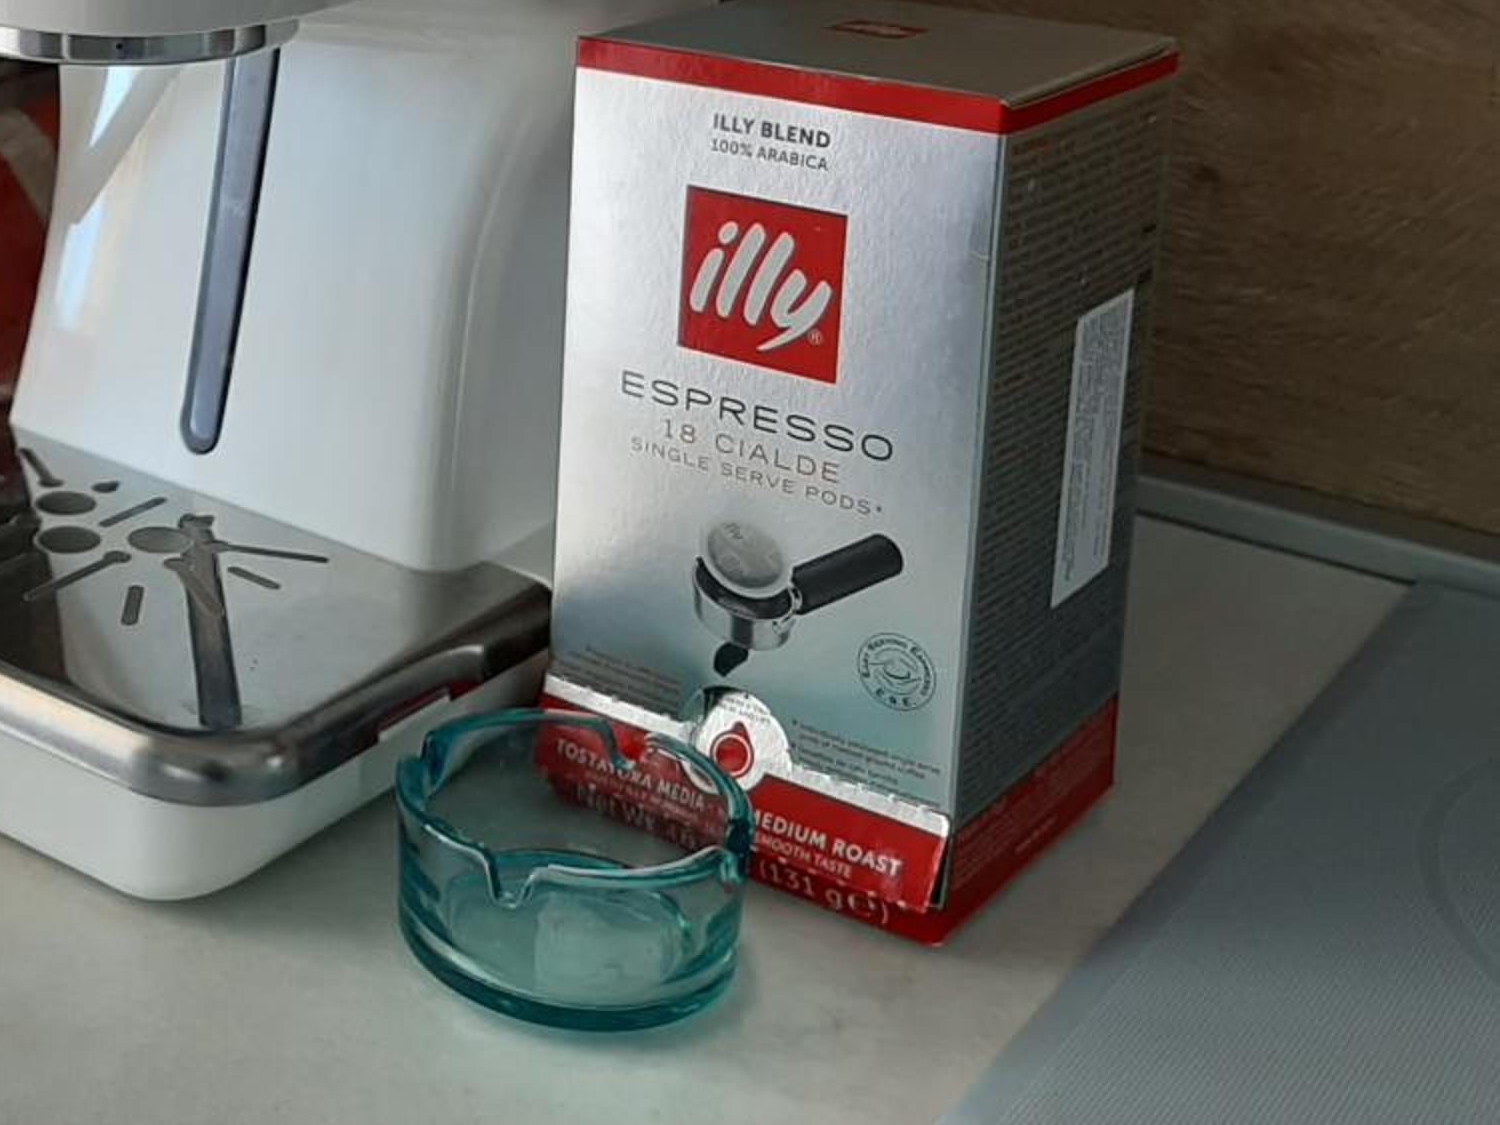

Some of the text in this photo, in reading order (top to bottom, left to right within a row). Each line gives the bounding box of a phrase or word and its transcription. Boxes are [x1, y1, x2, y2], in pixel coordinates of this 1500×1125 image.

[712, 113, 832, 149] ILLY BLEND
[710, 138, 829, 172] 100% ARABICA
[690, 221, 833, 353] illy
[621, 370, 894, 462] ESPRESSO
[630, 437, 709, 471] SINGLE
[720, 462, 797, 494] SERVE
[663, 419, 841, 484] 18 CIALDE
[656, 778, 706, 812] MEDIA
[813, 852, 852, 878] TASTE
[832, 838, 902, 876] ROAST
